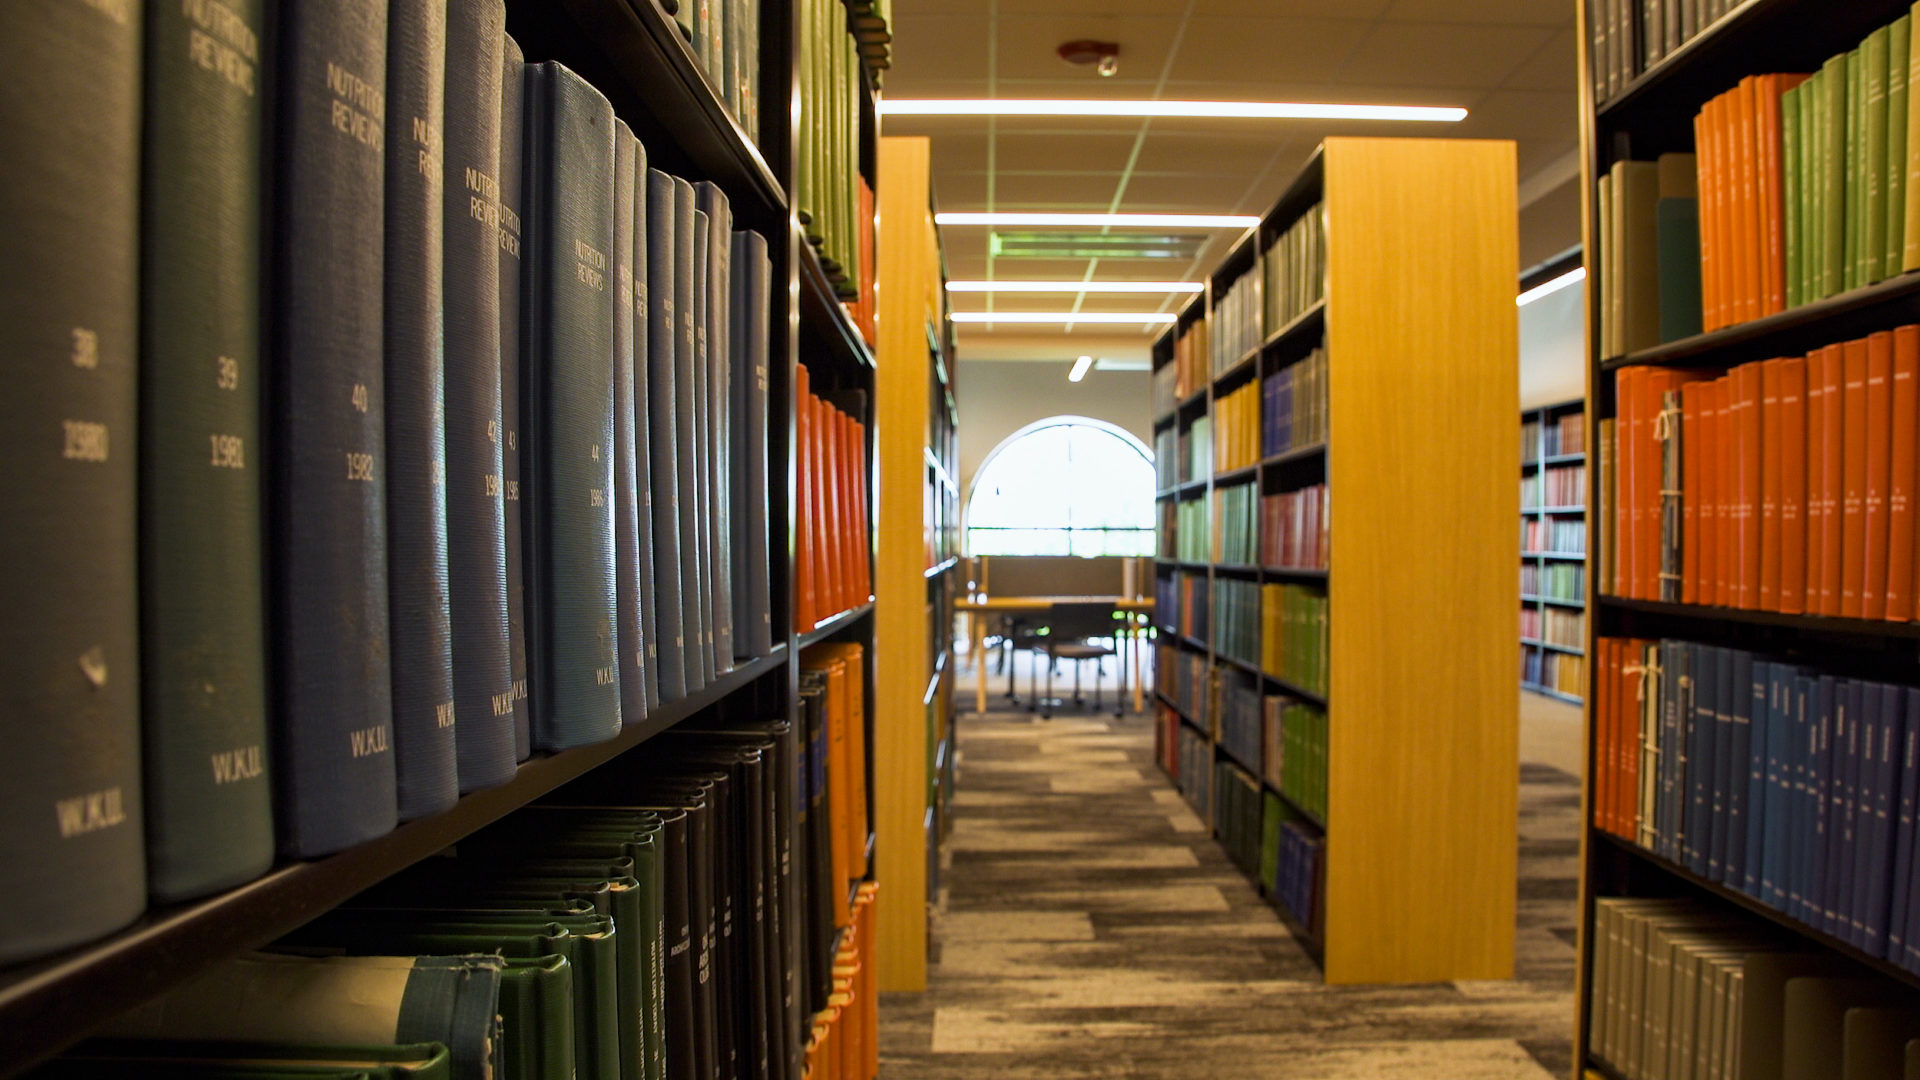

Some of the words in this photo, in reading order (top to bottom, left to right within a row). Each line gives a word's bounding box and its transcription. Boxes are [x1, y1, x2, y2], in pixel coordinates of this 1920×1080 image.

[575, 238, 606, 272] NUTRITION
[577, 262, 604, 291] REVIEWS
[217, 356, 238, 391] 39
[352, 384, 368, 413] 40
[210, 434, 245, 469] 1981
[508, 430, 517, 451] 43
[591, 444, 599, 462] 44
[346, 453, 374, 481] 1982
